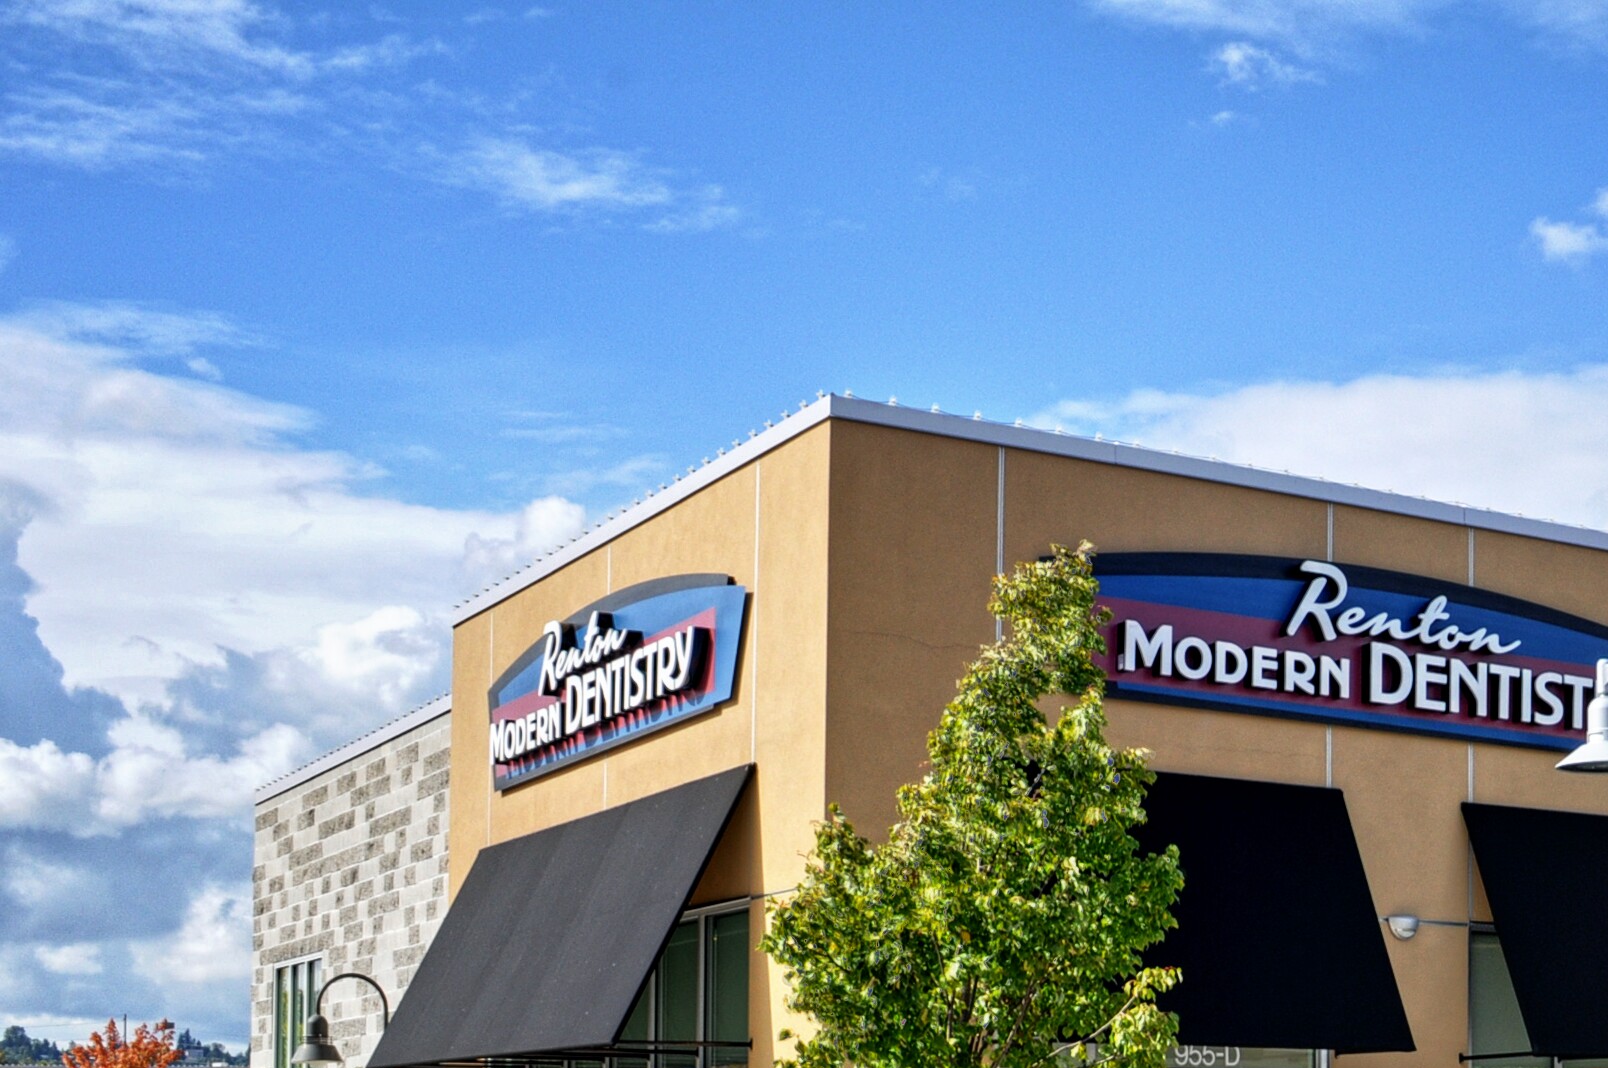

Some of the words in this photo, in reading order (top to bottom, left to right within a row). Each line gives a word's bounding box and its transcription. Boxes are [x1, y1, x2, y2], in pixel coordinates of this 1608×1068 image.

[1285, 560, 1522, 655] Renton
[489, 701, 562, 765] MODERN
[565, 625, 695, 735] DENTISTRY
[537, 610, 627, 696] Renton
[1123, 619, 1351, 699] MODERN
[1174, 1044, 1240, 1067] 955-D
